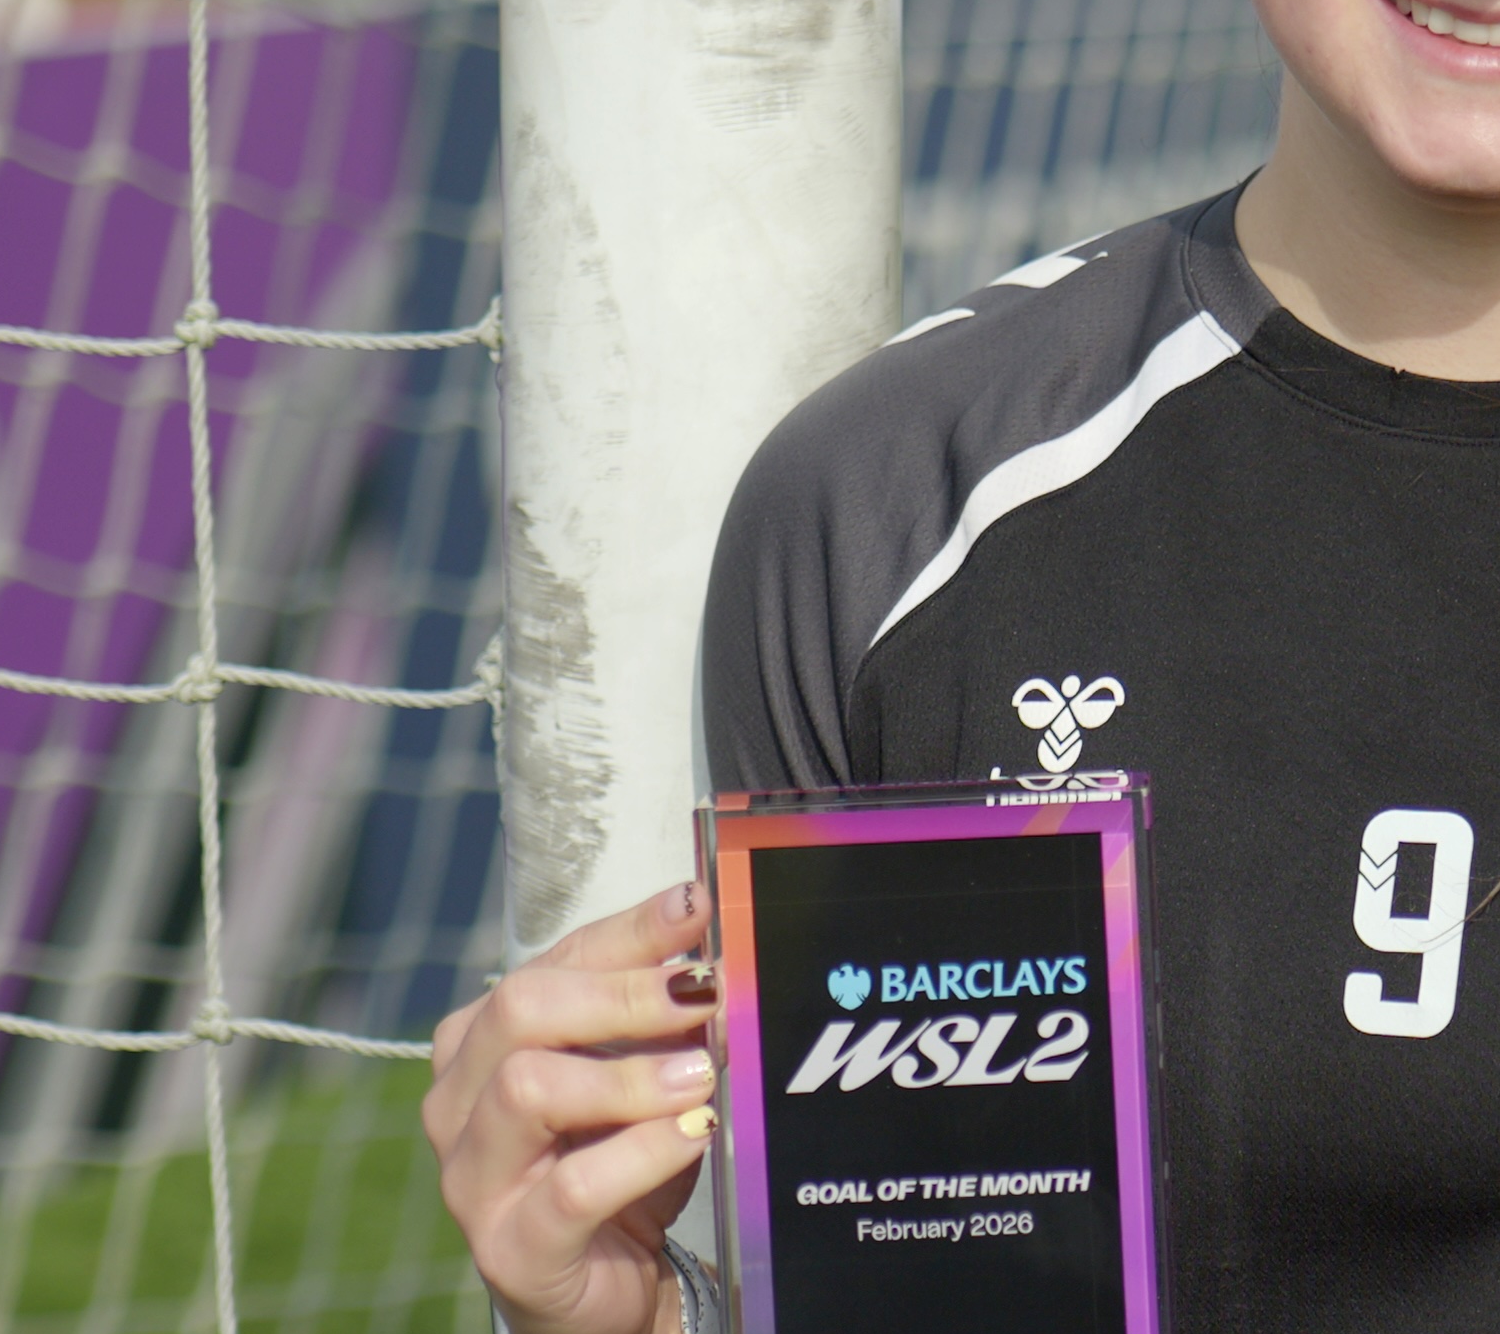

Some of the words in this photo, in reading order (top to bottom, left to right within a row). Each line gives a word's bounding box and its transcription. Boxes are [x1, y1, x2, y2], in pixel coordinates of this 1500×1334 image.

[1343, 808, 1475, 1039] 9
[880, 956, 1088, 1003] BARCLAYS
[785, 1009, 1090, 1095] WSL2
[796, 1181, 874, 1206] GOAL
[876, 1178, 917, 1202] OF
[919, 1176, 978, 1200] THE
[979, 1169, 1091, 1197] MONTH
[856, 1217, 965, 1243] February
[969, 1211, 1034, 1238] 2026
